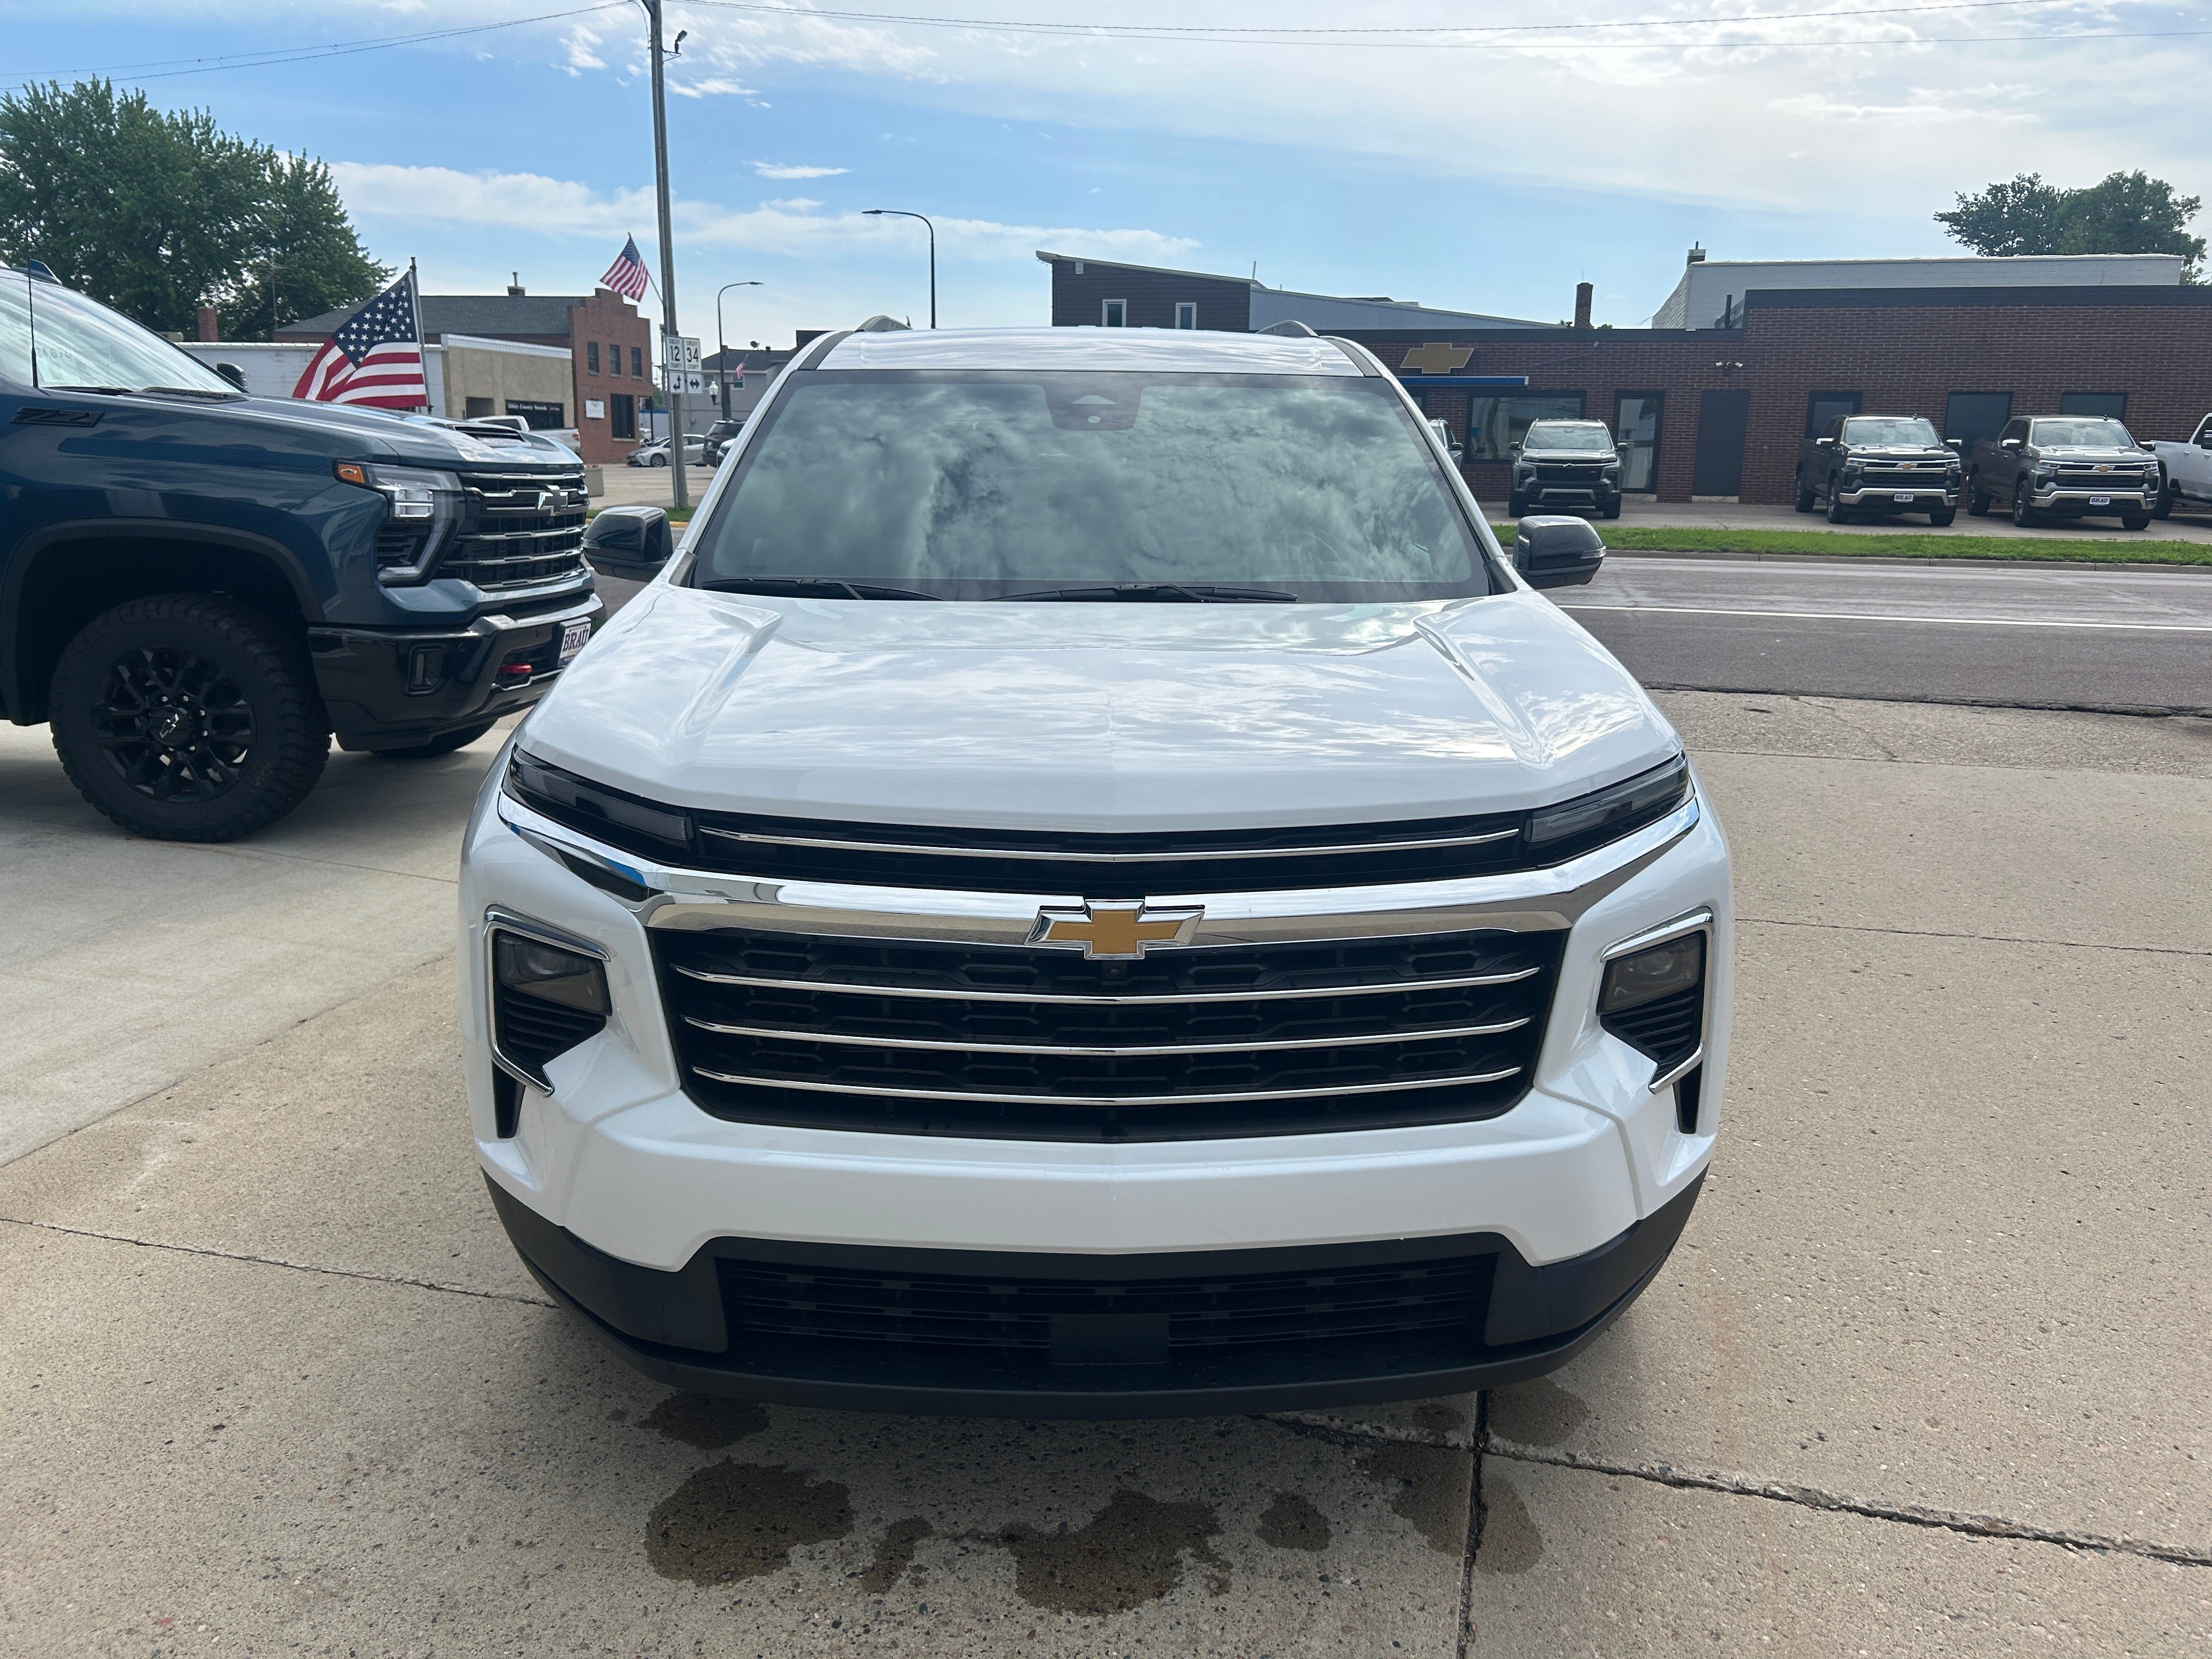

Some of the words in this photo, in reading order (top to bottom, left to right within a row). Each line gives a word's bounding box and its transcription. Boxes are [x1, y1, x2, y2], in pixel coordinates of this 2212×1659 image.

[670, 345, 680, 362] 12
[686, 347, 698, 363] 34
[562, 628, 589, 652] BRAU
